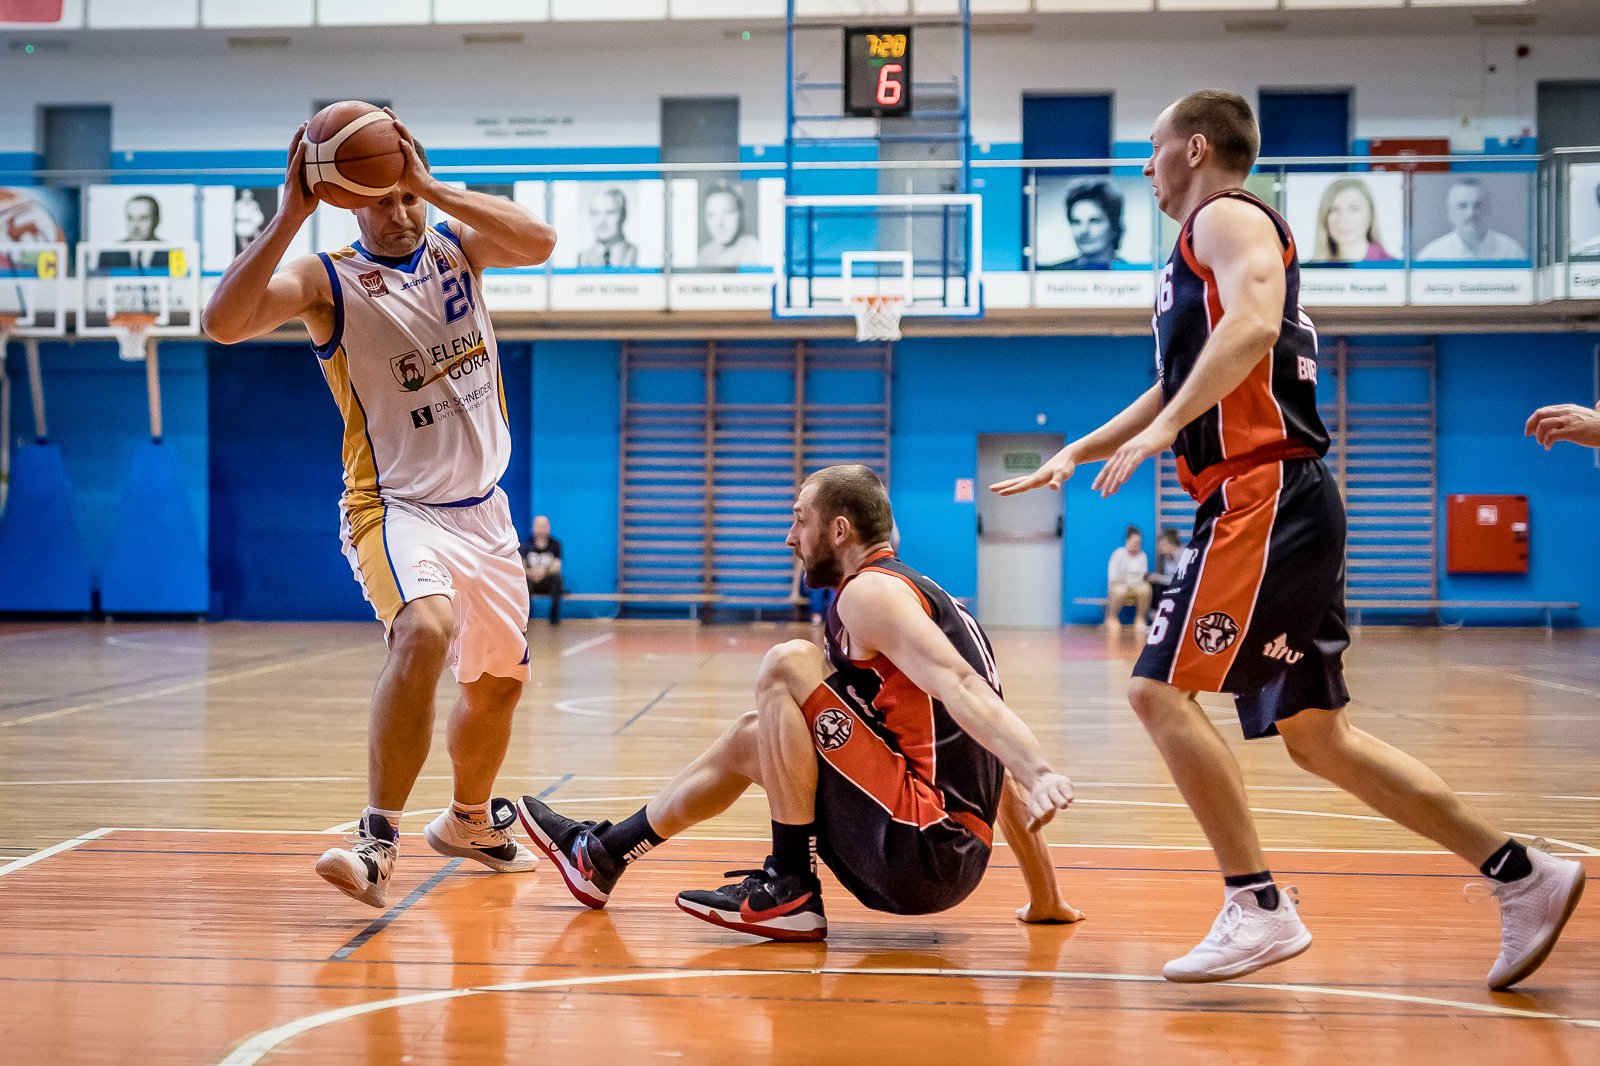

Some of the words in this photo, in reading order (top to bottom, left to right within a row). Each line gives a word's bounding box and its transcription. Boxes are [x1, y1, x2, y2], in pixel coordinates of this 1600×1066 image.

[876, 64, 903, 105] 6
[440, 270, 475, 325] 21
[447, 349, 491, 380] GÓRA
[434, 400, 452, 413] DR.
[453, 381, 492, 408] SCHNEIDER
